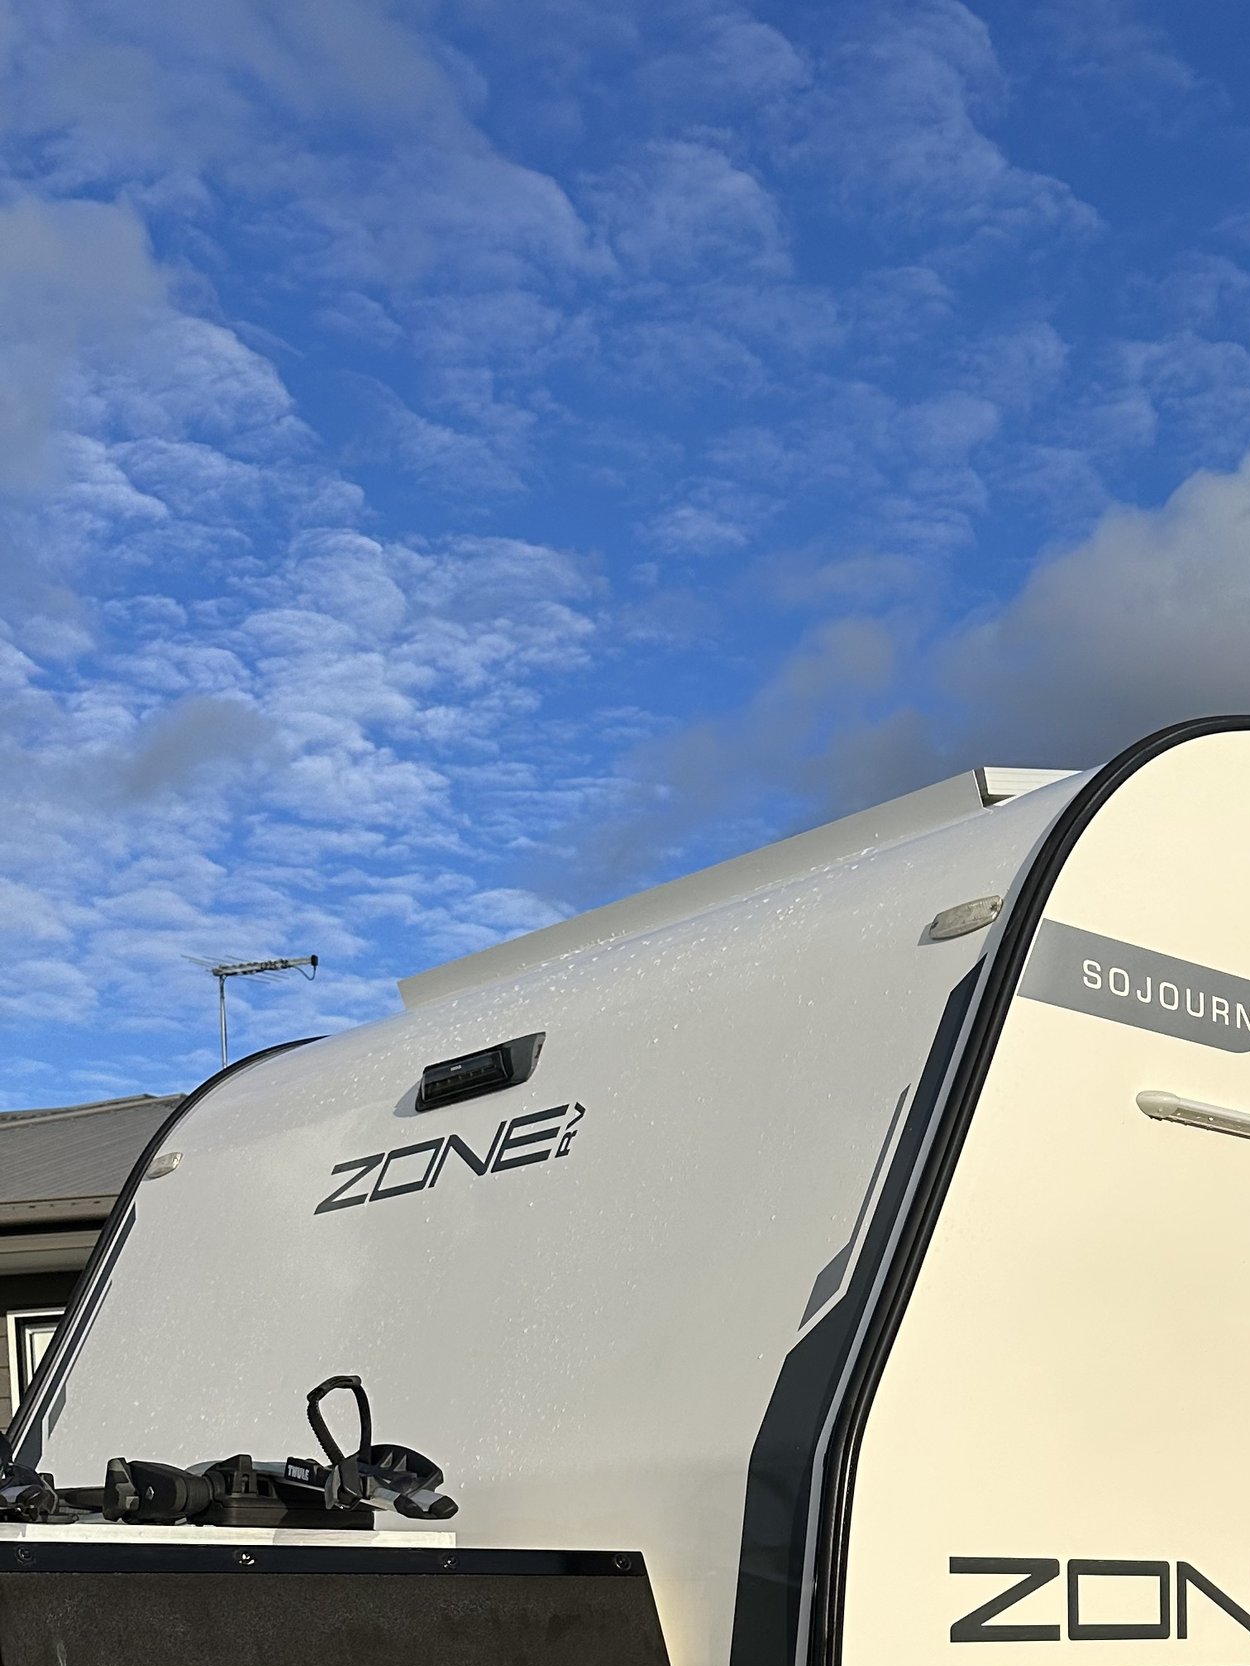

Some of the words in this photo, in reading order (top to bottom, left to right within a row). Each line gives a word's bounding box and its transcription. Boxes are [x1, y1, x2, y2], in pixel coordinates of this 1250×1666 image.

[313, 1103, 570, 1216] ZONE
[554, 1101, 586, 1159] RV
[288, 1465, 310, 1481] THULE
